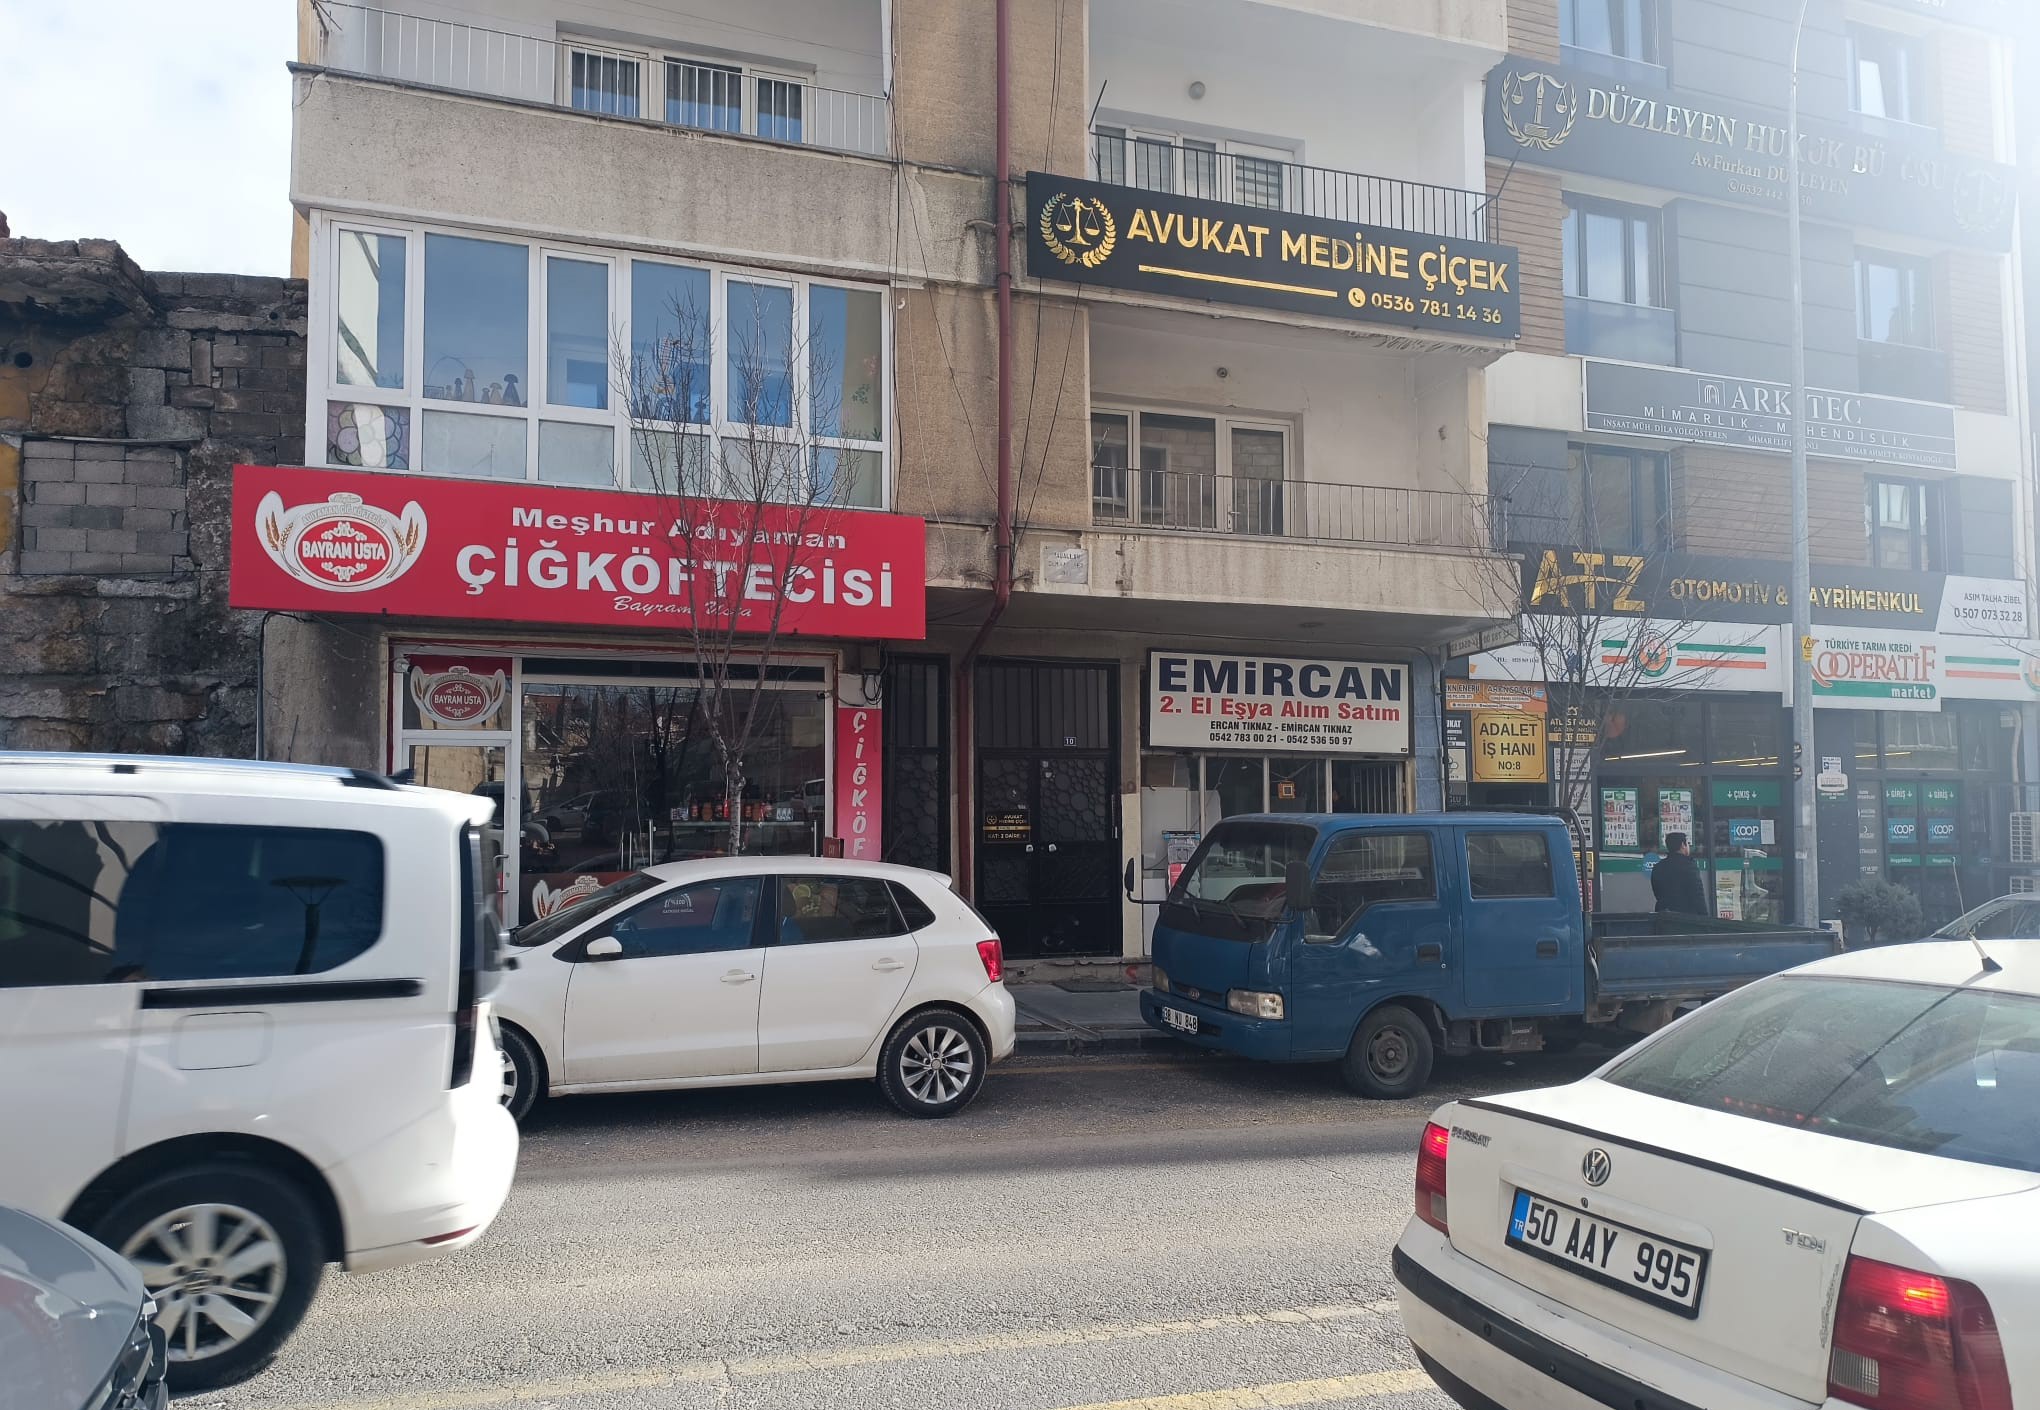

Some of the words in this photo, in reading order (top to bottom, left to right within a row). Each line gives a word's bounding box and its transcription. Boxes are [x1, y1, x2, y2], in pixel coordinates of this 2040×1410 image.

[1586, 84, 1737, 148] DÜZLEYEN
[1767, 164, 1848, 195] DÜLEYEN
[1127, 208, 1270, 257] AVUKAT
[1282, 230, 1409, 280] MEDİNE
[1418, 244, 1510, 296] ÇİÇEK
[1371, 292, 1415, 312] 0536
[1420, 299, 1451, 318] 781
[1456, 304, 1477, 321] 14
[1482, 307, 1502, 324] 36
[1731, 385, 1862, 424] ARKTEC
[1603, 417, 1631, 430] İNŞAAT
[1654, 423, 1673, 433] DİLA
[1643, 405, 1749, 429] MİMARLIK
[1777, 422, 1911, 447] MHENDİSLİK
[512, 507, 655, 535] Meşhur
[668, 518, 846, 549] Adıyaman
[302, 540, 352, 560] BAYRAM
[354, 542, 386, 561] USTA
[456, 537, 892, 608] ÇİĞKÖFTECİSİ
[1530, 549, 1645, 612] ATZ
[1670, 578, 1770, 605] OTOMOTİV
[1775, 584, 1789, 607] &
[1810, 584, 1924, 614] AYRİMENKUL
[613, 595, 693, 616] Bayram
[1964, 592, 1980, 601] ASIM
[1981, 594, 2001, 603] TALHA
[1954, 607, 1960, 618] 0
[1962, 607, 1979, 619] 507
[1981, 609, 1998, 621] 073
[2000, 610, 2011, 621] 32
[2012, 611, 2023, 622] 28
[1824, 637, 1860, 651] TÜRKİYE
[1861, 641, 1887, 652] TARIM
[1889, 640, 1912, 653] KREDİ
[434, 694, 463, 705] BAYRAM
[465, 695, 482, 705] USTA
[1891, 686, 1932, 699] market
[1159, 695, 1182, 713] 2.
[1191, 696, 1211, 714] El
[1221, 697, 1273, 720] Eşya
[1280, 700, 1329, 719] Alım
[1338, 702, 1400, 721] Satım
[1210, 720, 1239, 730] ERCAN
[1242, 721, 1272, 731] TIKNAZ
[1281, 721, 1320, 733] EMİRCAN
[1323, 724, 1352, 734] TIKNAZ
[1479, 722, 1538, 737] ADALET
[1209, 732, 1232, 742] 0542
[1234, 733, 1251, 742] 783
[1253, 734, 1264, 743] 00
[1266, 734, 1277, 743] 21
[1286, 735, 1308, 744] 0542
[1310, 736, 1327, 745] 536
[1329, 736, 1340, 745] 50
[1342, 737, 1353, 746] 97
[1483, 739, 1496, 759] İŞ
[1500, 742, 1535, 756] HANI
[1498, 761, 1521, 770] NO:8
[1733, 790, 1750, 800] ÇIKIŞ
[1890, 787, 1906, 800] GİRİŞ
[1733, 825, 1759, 836] KOOP
[1892, 824, 1914, 834] KOOP
[1931, 824, 1954, 834] KOOP
[1185, 1014, 1197, 1030] 848
[1451, 1125, 1492, 1148] PASSAT
[1781, 1227, 1826, 1254] TDI
[1514, 1218, 1524, 1232] TR
[1526, 1202, 1558, 1246] 50
[1565, 1217, 1618, 1269] AAY
[1634, 1242, 1695, 1298] 995
